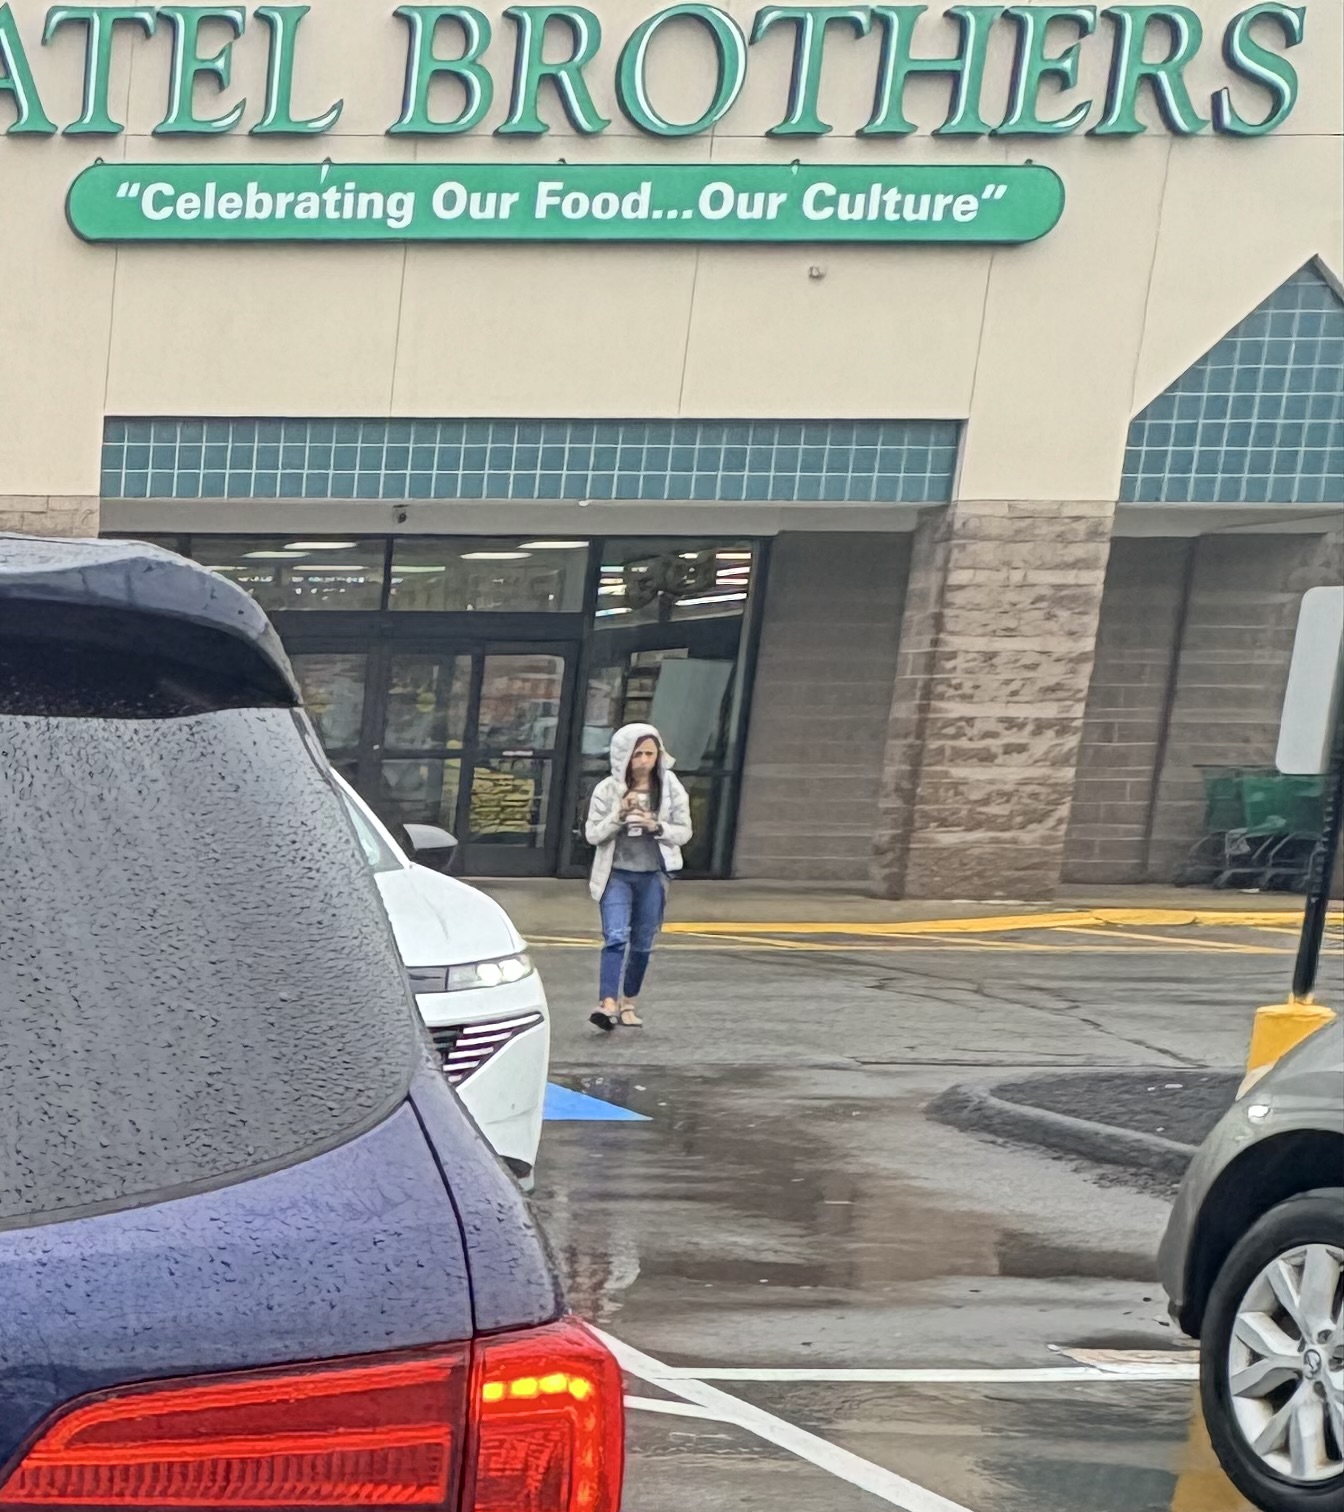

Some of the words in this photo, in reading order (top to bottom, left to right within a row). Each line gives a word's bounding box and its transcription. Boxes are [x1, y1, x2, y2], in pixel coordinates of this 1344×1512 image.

[386, 3, 1307, 138] BROTHERS
[116, 181, 415, 229] “Celebrating
[432, 182, 520, 220] Our
[802, 182, 1008, 222] Culture”
